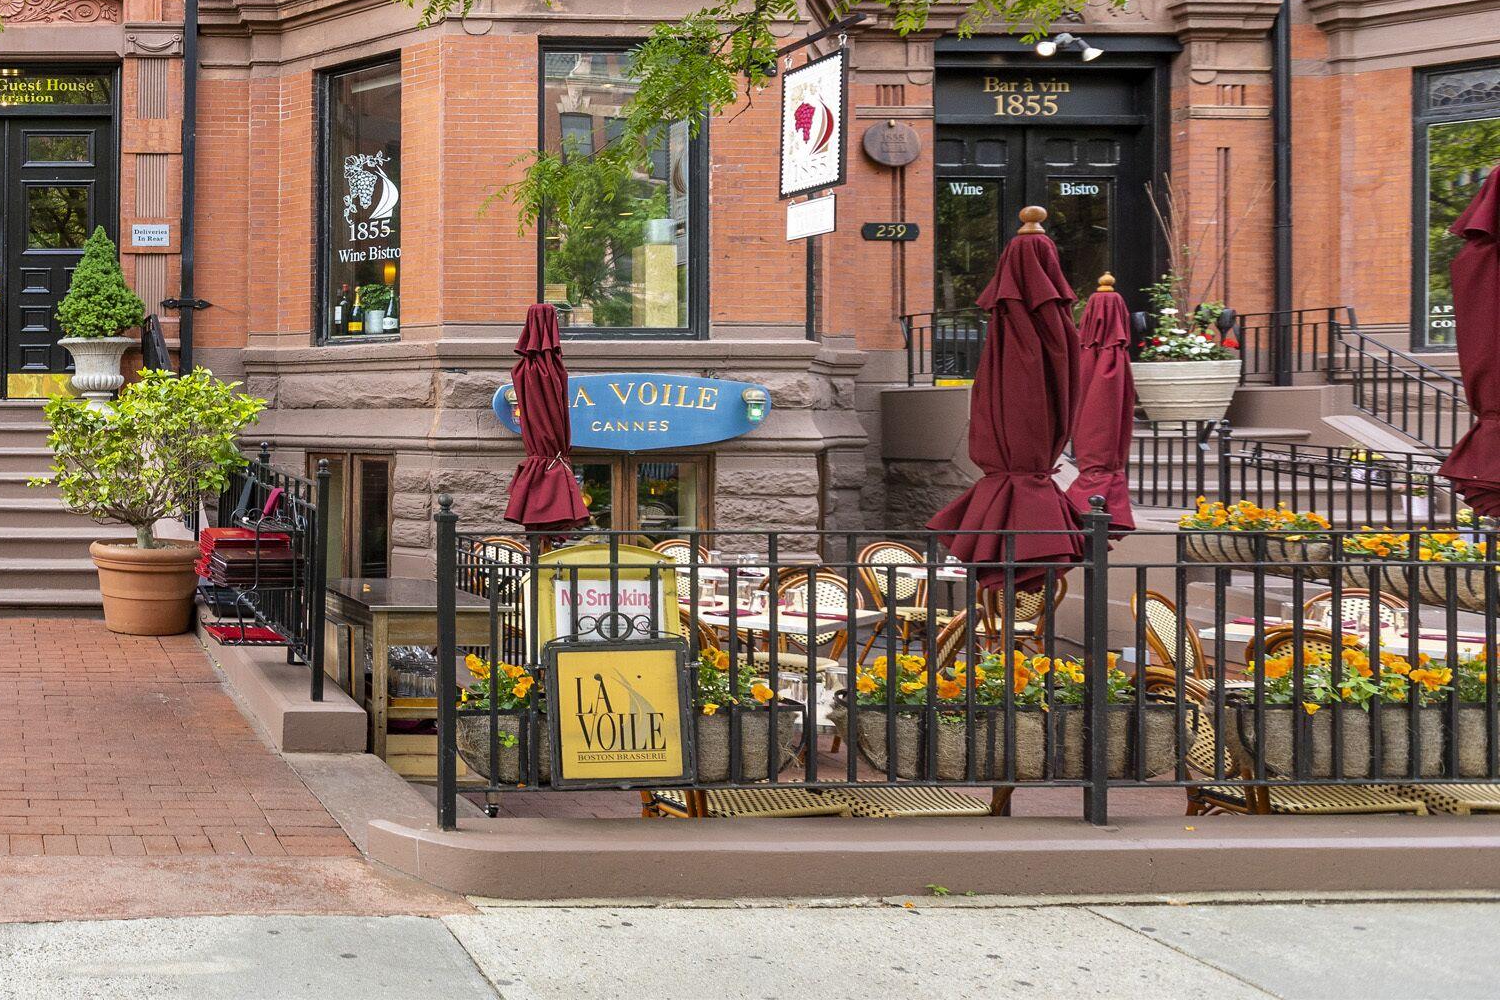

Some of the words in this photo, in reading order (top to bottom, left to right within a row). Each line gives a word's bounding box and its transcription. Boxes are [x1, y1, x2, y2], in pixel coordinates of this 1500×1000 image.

[47, 78, 95, 92] House
[982, 76, 1019, 93] Bar
[1023, 78, 1034, 93] à
[1038, 77, 1071, 93] vin
[993, 94, 1059, 116] 1855
[949, 181, 984, 196] Wine
[1059, 181, 1100, 196] Bistro
[348, 219, 392, 242] 1855
[875, 224, 907, 238] 259
[338, 249, 367, 263] Wine
[368, 245, 402, 260] Bistro
[567, 386, 597, 409] A
[607, 381, 719, 411] VOILE
[591, 420, 670, 433] CANNES
[574, 676, 616, 714] LA
[575, 712, 667, 751] VOILE
[616, 752, 667, 760] BRASSERIE
